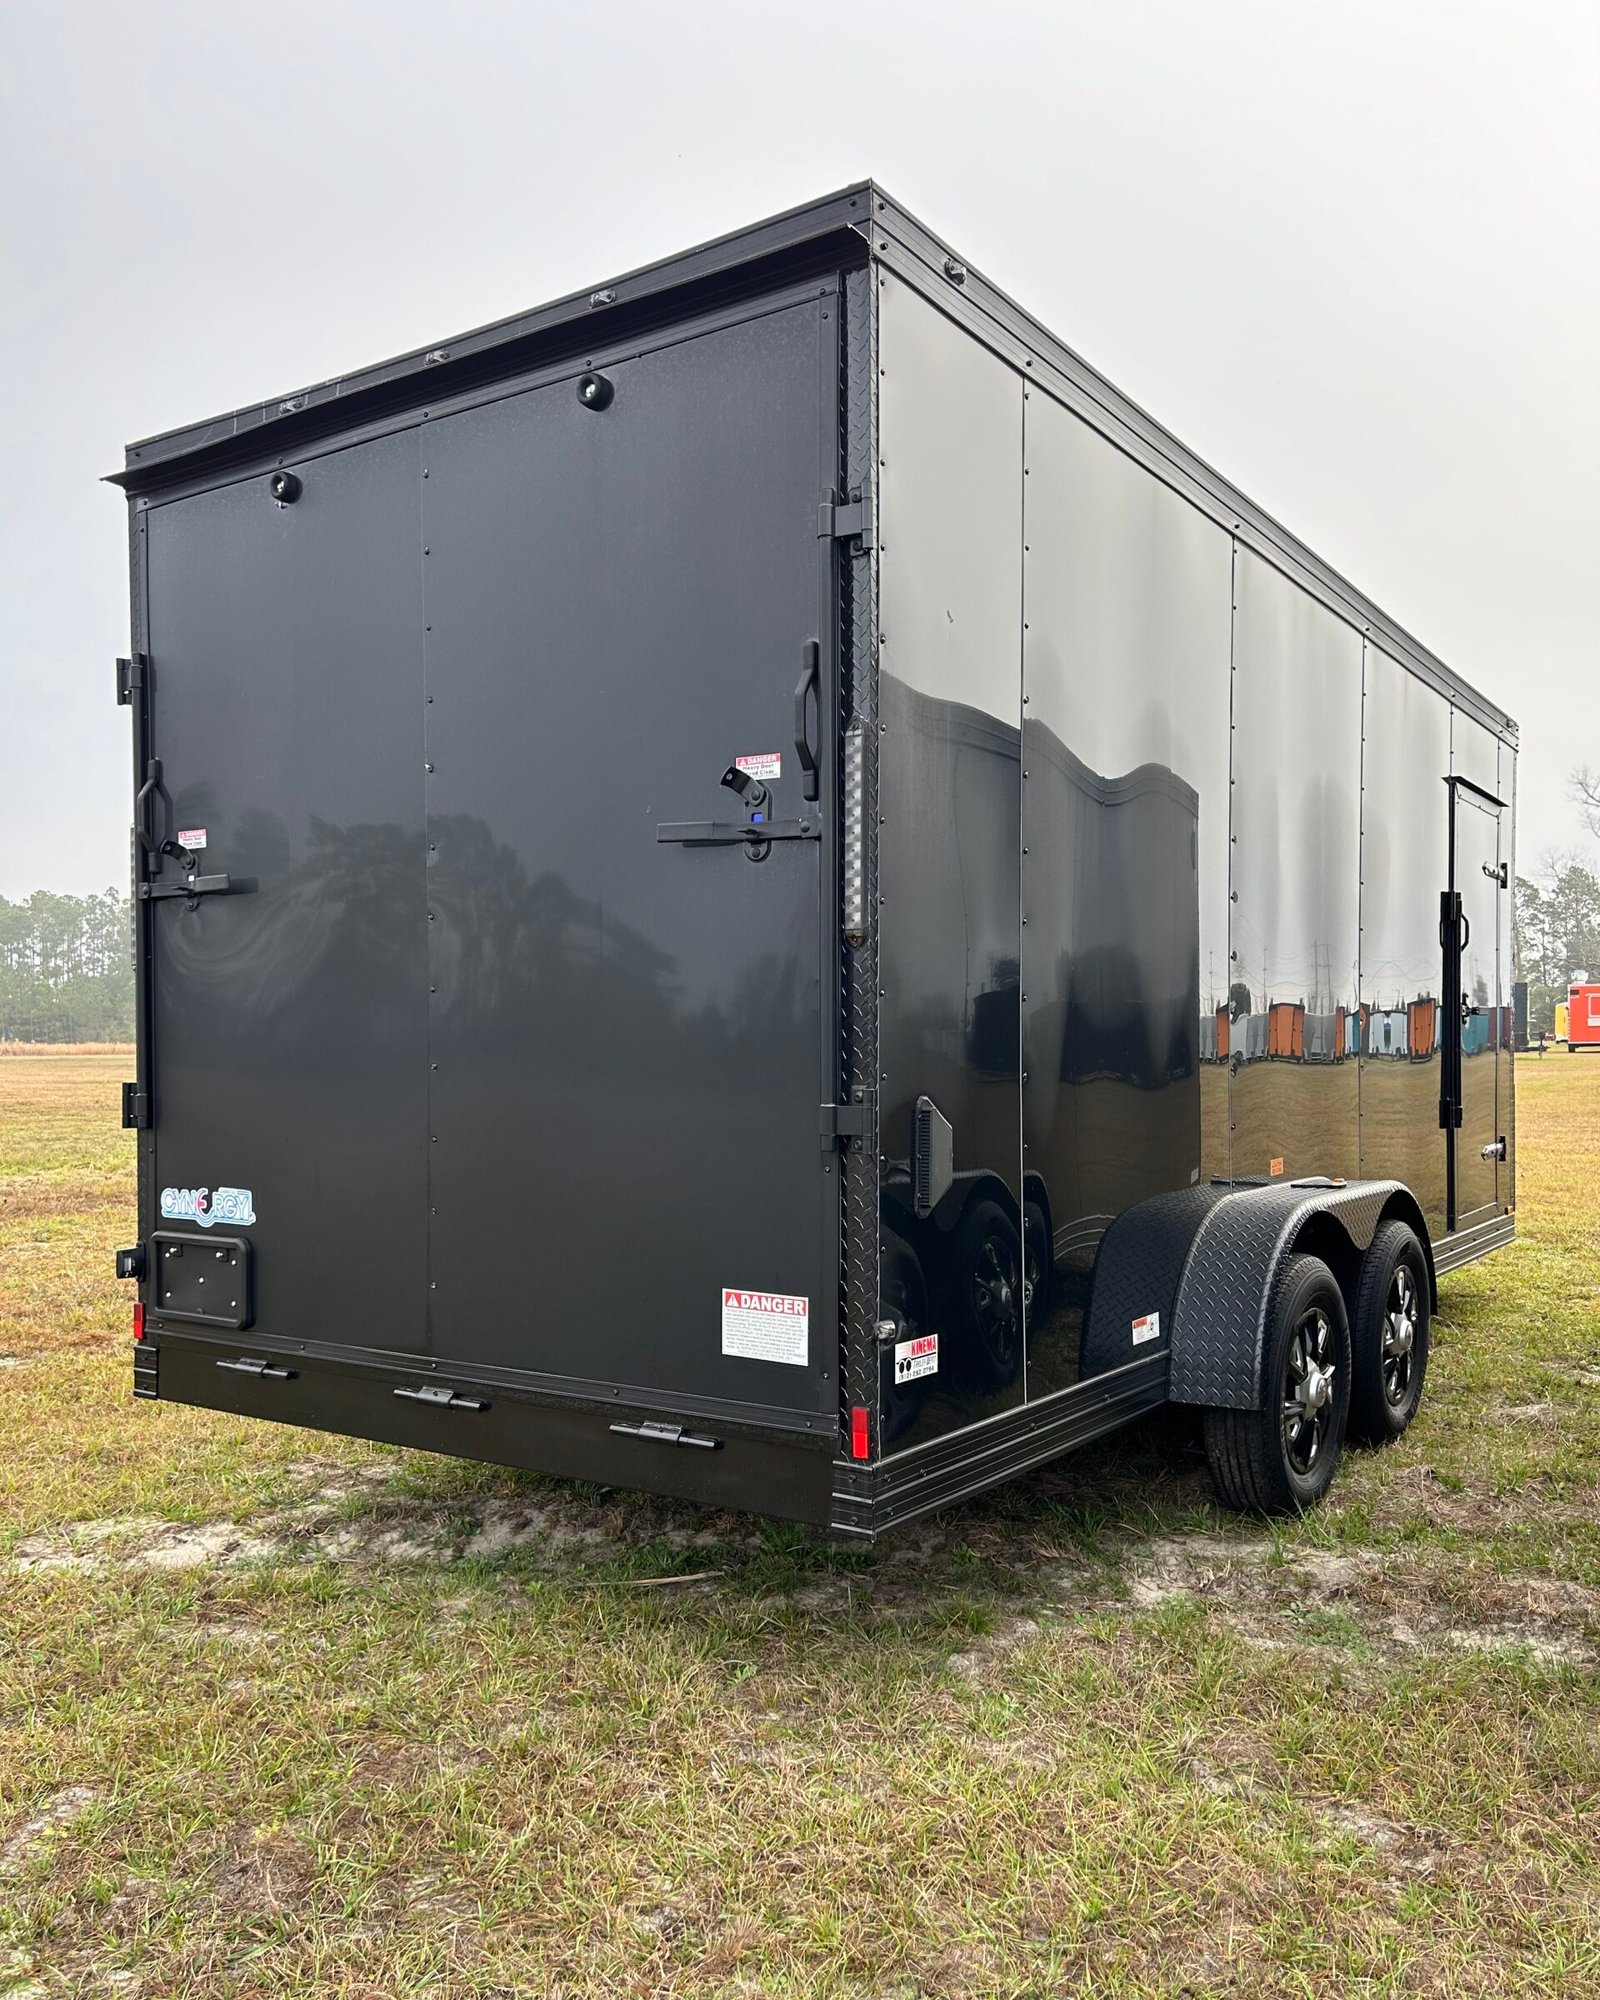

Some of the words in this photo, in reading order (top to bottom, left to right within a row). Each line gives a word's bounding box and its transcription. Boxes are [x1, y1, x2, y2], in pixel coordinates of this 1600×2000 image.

[748, 754, 777, 764] DANGER
[740, 1294, 805, 1315] DANGER
[911, 1335, 937, 1357] KINEMA
